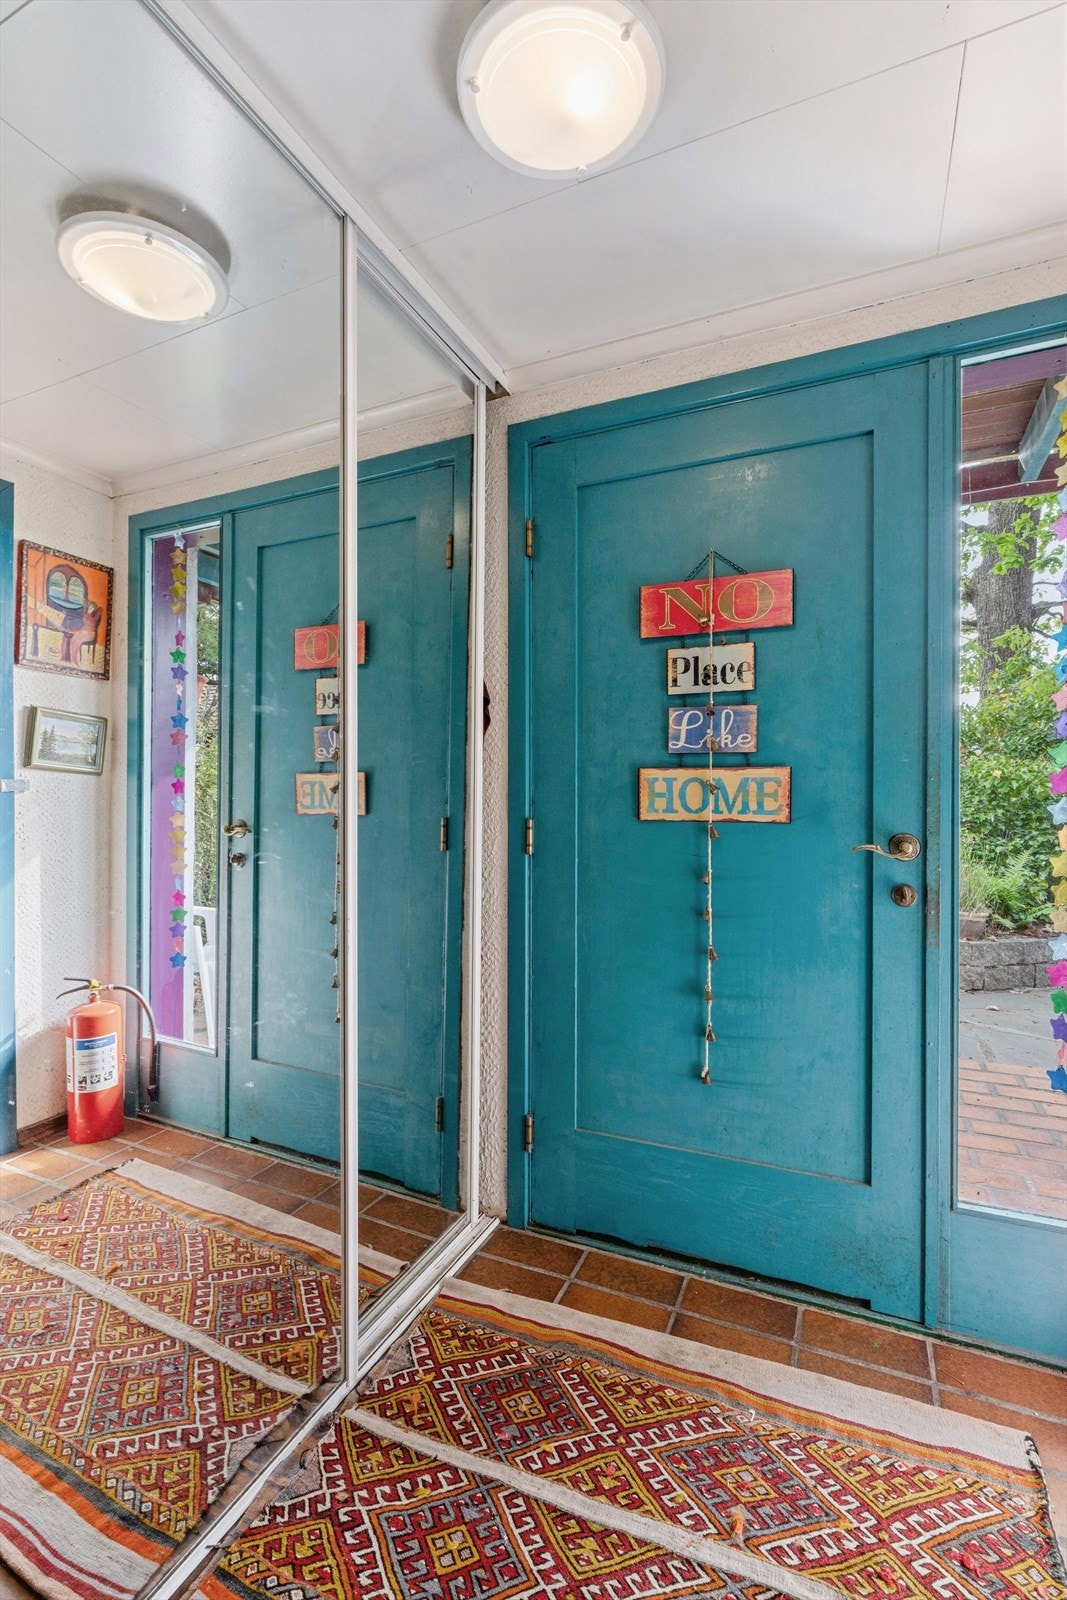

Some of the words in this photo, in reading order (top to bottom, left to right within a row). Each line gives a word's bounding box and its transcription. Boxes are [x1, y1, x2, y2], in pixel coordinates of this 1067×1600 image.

[659, 578, 775, 630] NO
[669, 656, 753, 688] Place
[669, 709, 754, 748] Like
[644, 776, 784, 816] HOME
